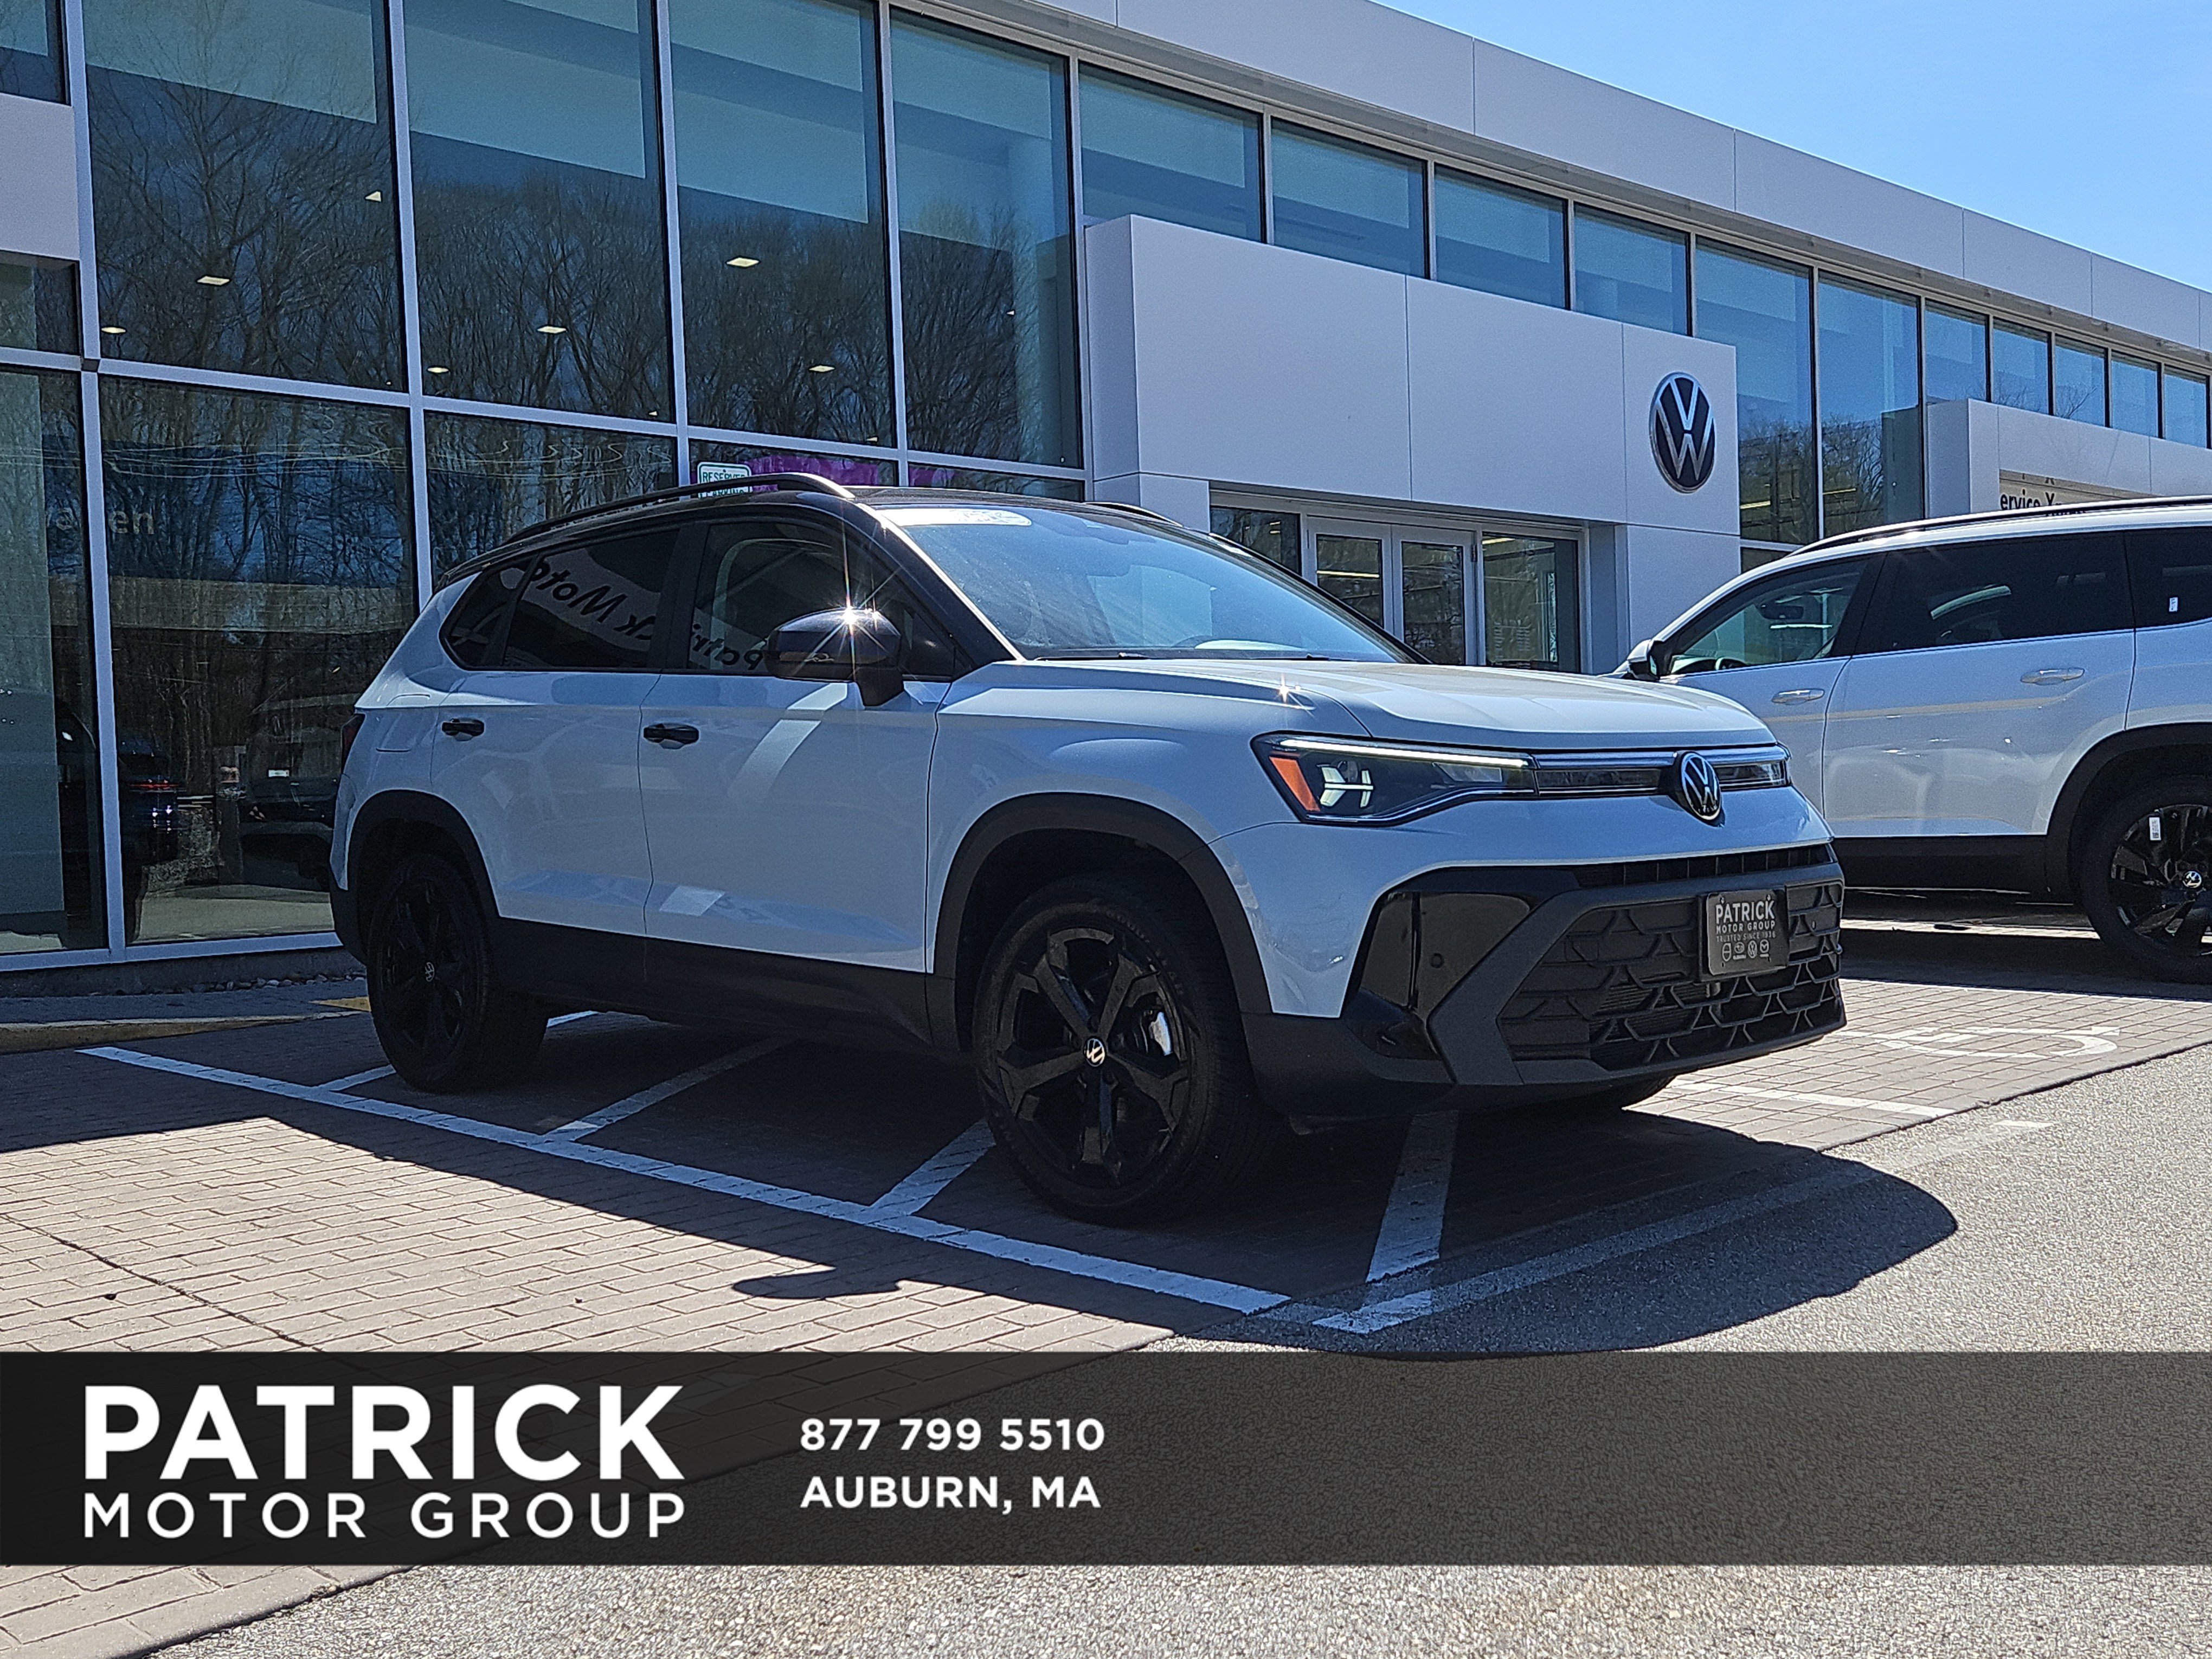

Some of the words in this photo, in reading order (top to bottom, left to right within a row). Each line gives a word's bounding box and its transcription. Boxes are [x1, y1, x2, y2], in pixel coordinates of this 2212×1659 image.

[1715, 901, 1774, 924] PATRICK
[1716, 923, 1743, 934] MOTOR
[1747, 920, 1776, 931] GROUP
